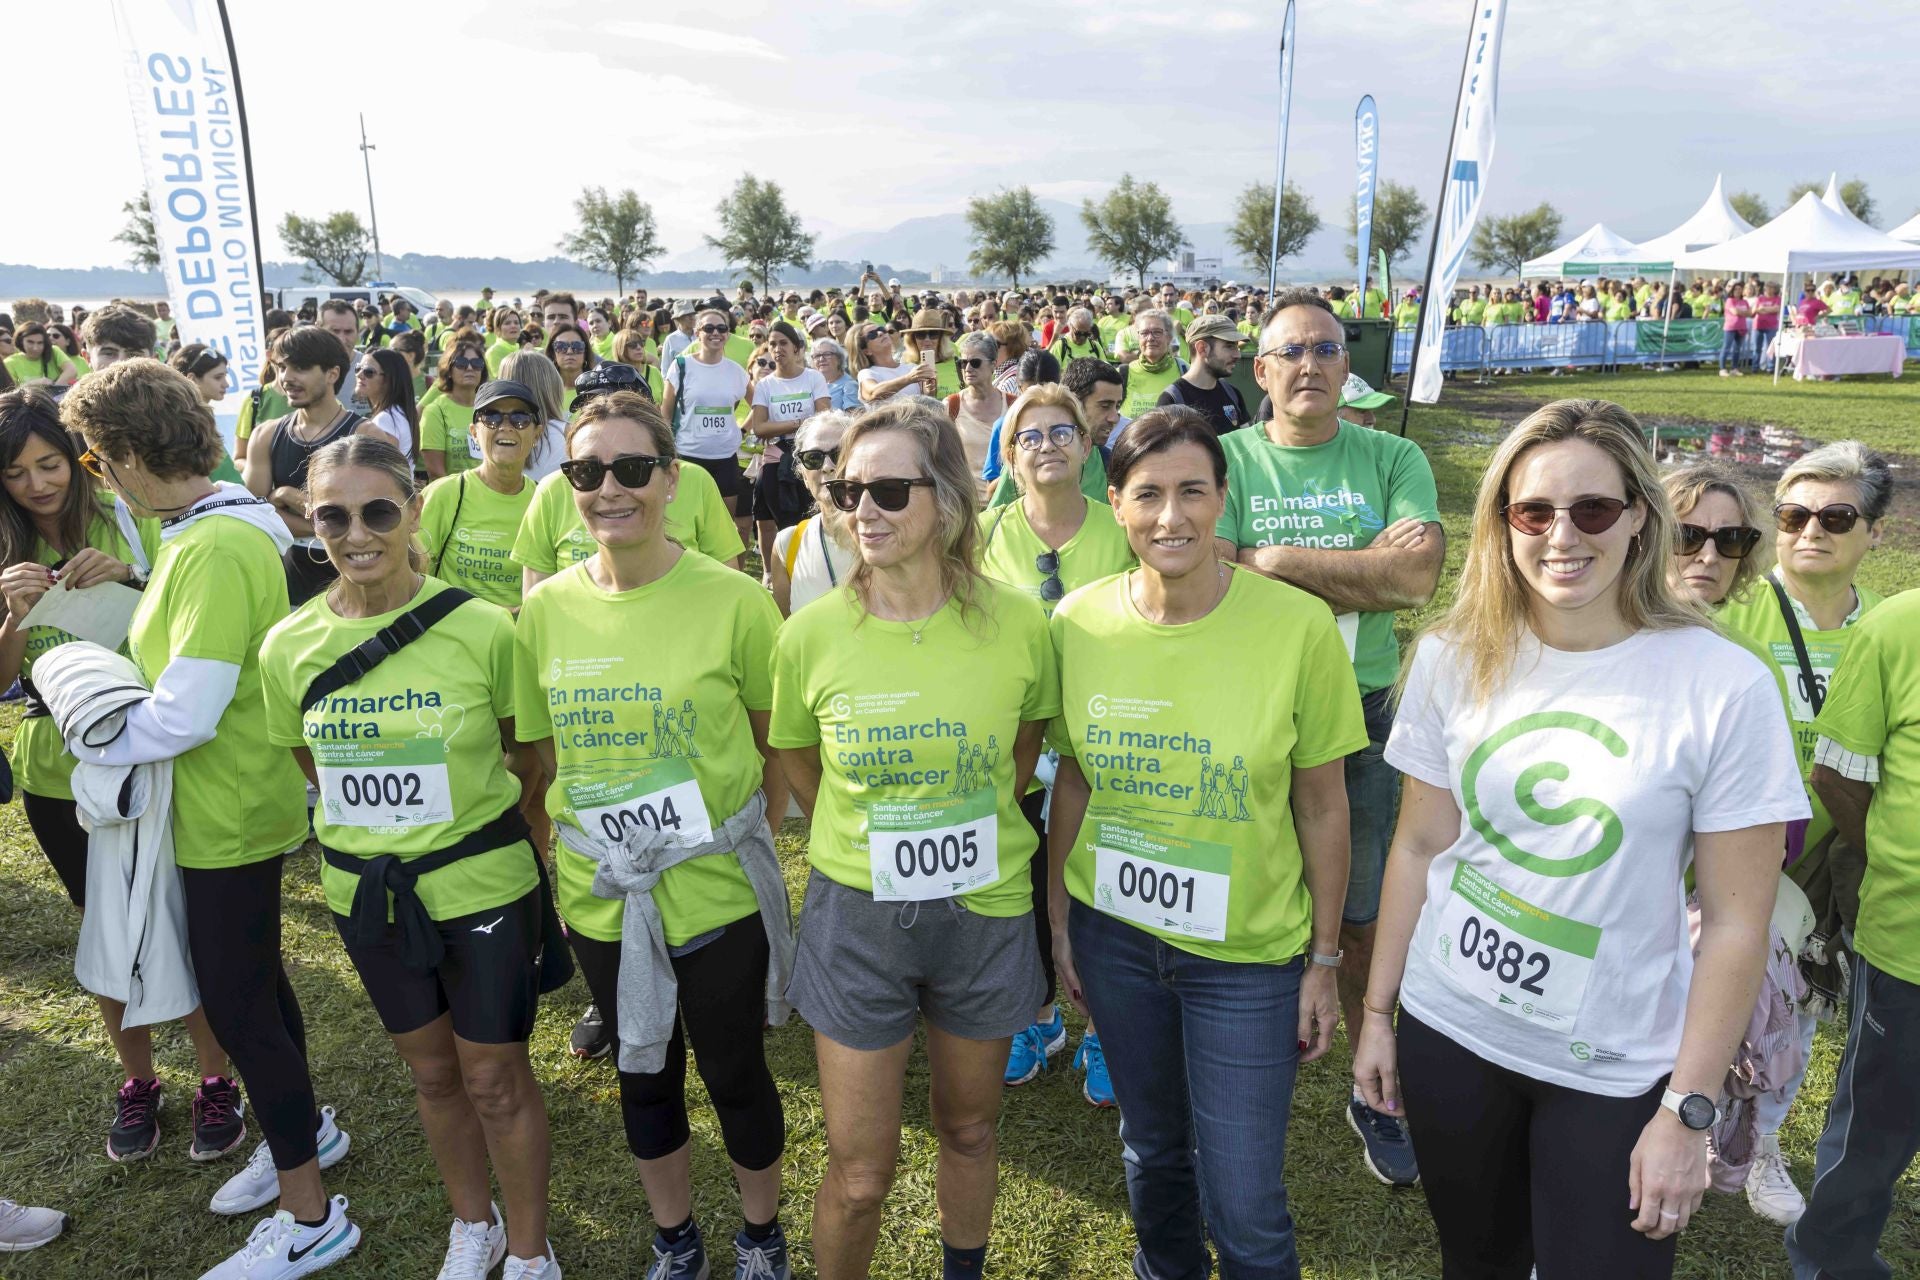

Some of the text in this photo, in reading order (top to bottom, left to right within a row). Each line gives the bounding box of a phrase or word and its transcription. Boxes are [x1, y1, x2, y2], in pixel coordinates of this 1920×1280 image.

[780, 401, 803, 415] 0172
[702, 416, 726, 428] 0163
[1250, 489, 1366, 513] En marcha
[1252, 513, 1325, 532] contra
[458, 543, 475, 555] En
[1280, 531, 1356, 549] cáncer
[457, 556, 503, 571] contra
[572, 549, 589, 561] En
[457, 567, 520, 584] el cáncer
[331, 688, 442, 714] marcha
[550, 682, 663, 706] En marcha
[554, 706, 614, 728] contra
[560, 728, 649, 750] l cáncer
[835, 717, 968, 744] En marcha
[1086, 724, 1212, 755] En marcha
[316, 742, 359, 751] Santander
[346, 750, 354, 758] el
[355, 749, 385, 758] cáncer
[837, 746, 914, 767] contra
[1086, 751, 1161, 773] contra
[866, 767, 950, 788] cáncer
[1095, 772, 1194, 800] l cáncer
[342, 772, 424, 807] 0002
[568, 782, 607, 795] Santander
[572, 793, 596, 801] contra
[605, 782, 634, 796] cáncer
[872, 803, 917, 812] Santander
[873, 809, 944, 821] contra el cáncer
[1101, 823, 1144, 838] Santander
[1101, 832, 1128, 843] contra
[1129, 837, 1138, 845] el
[1139, 840, 1168, 852] cáncer
[895, 829, 978, 878] 0005
[1119, 861, 1195, 913] 0001
[1462, 864, 1500, 894] Santander
[1460, 875, 1482, 894] contra
[1483, 891, 1491, 901] el
[1492, 898, 1521, 918] cáncer
[1460, 916, 1551, 996] 0382
